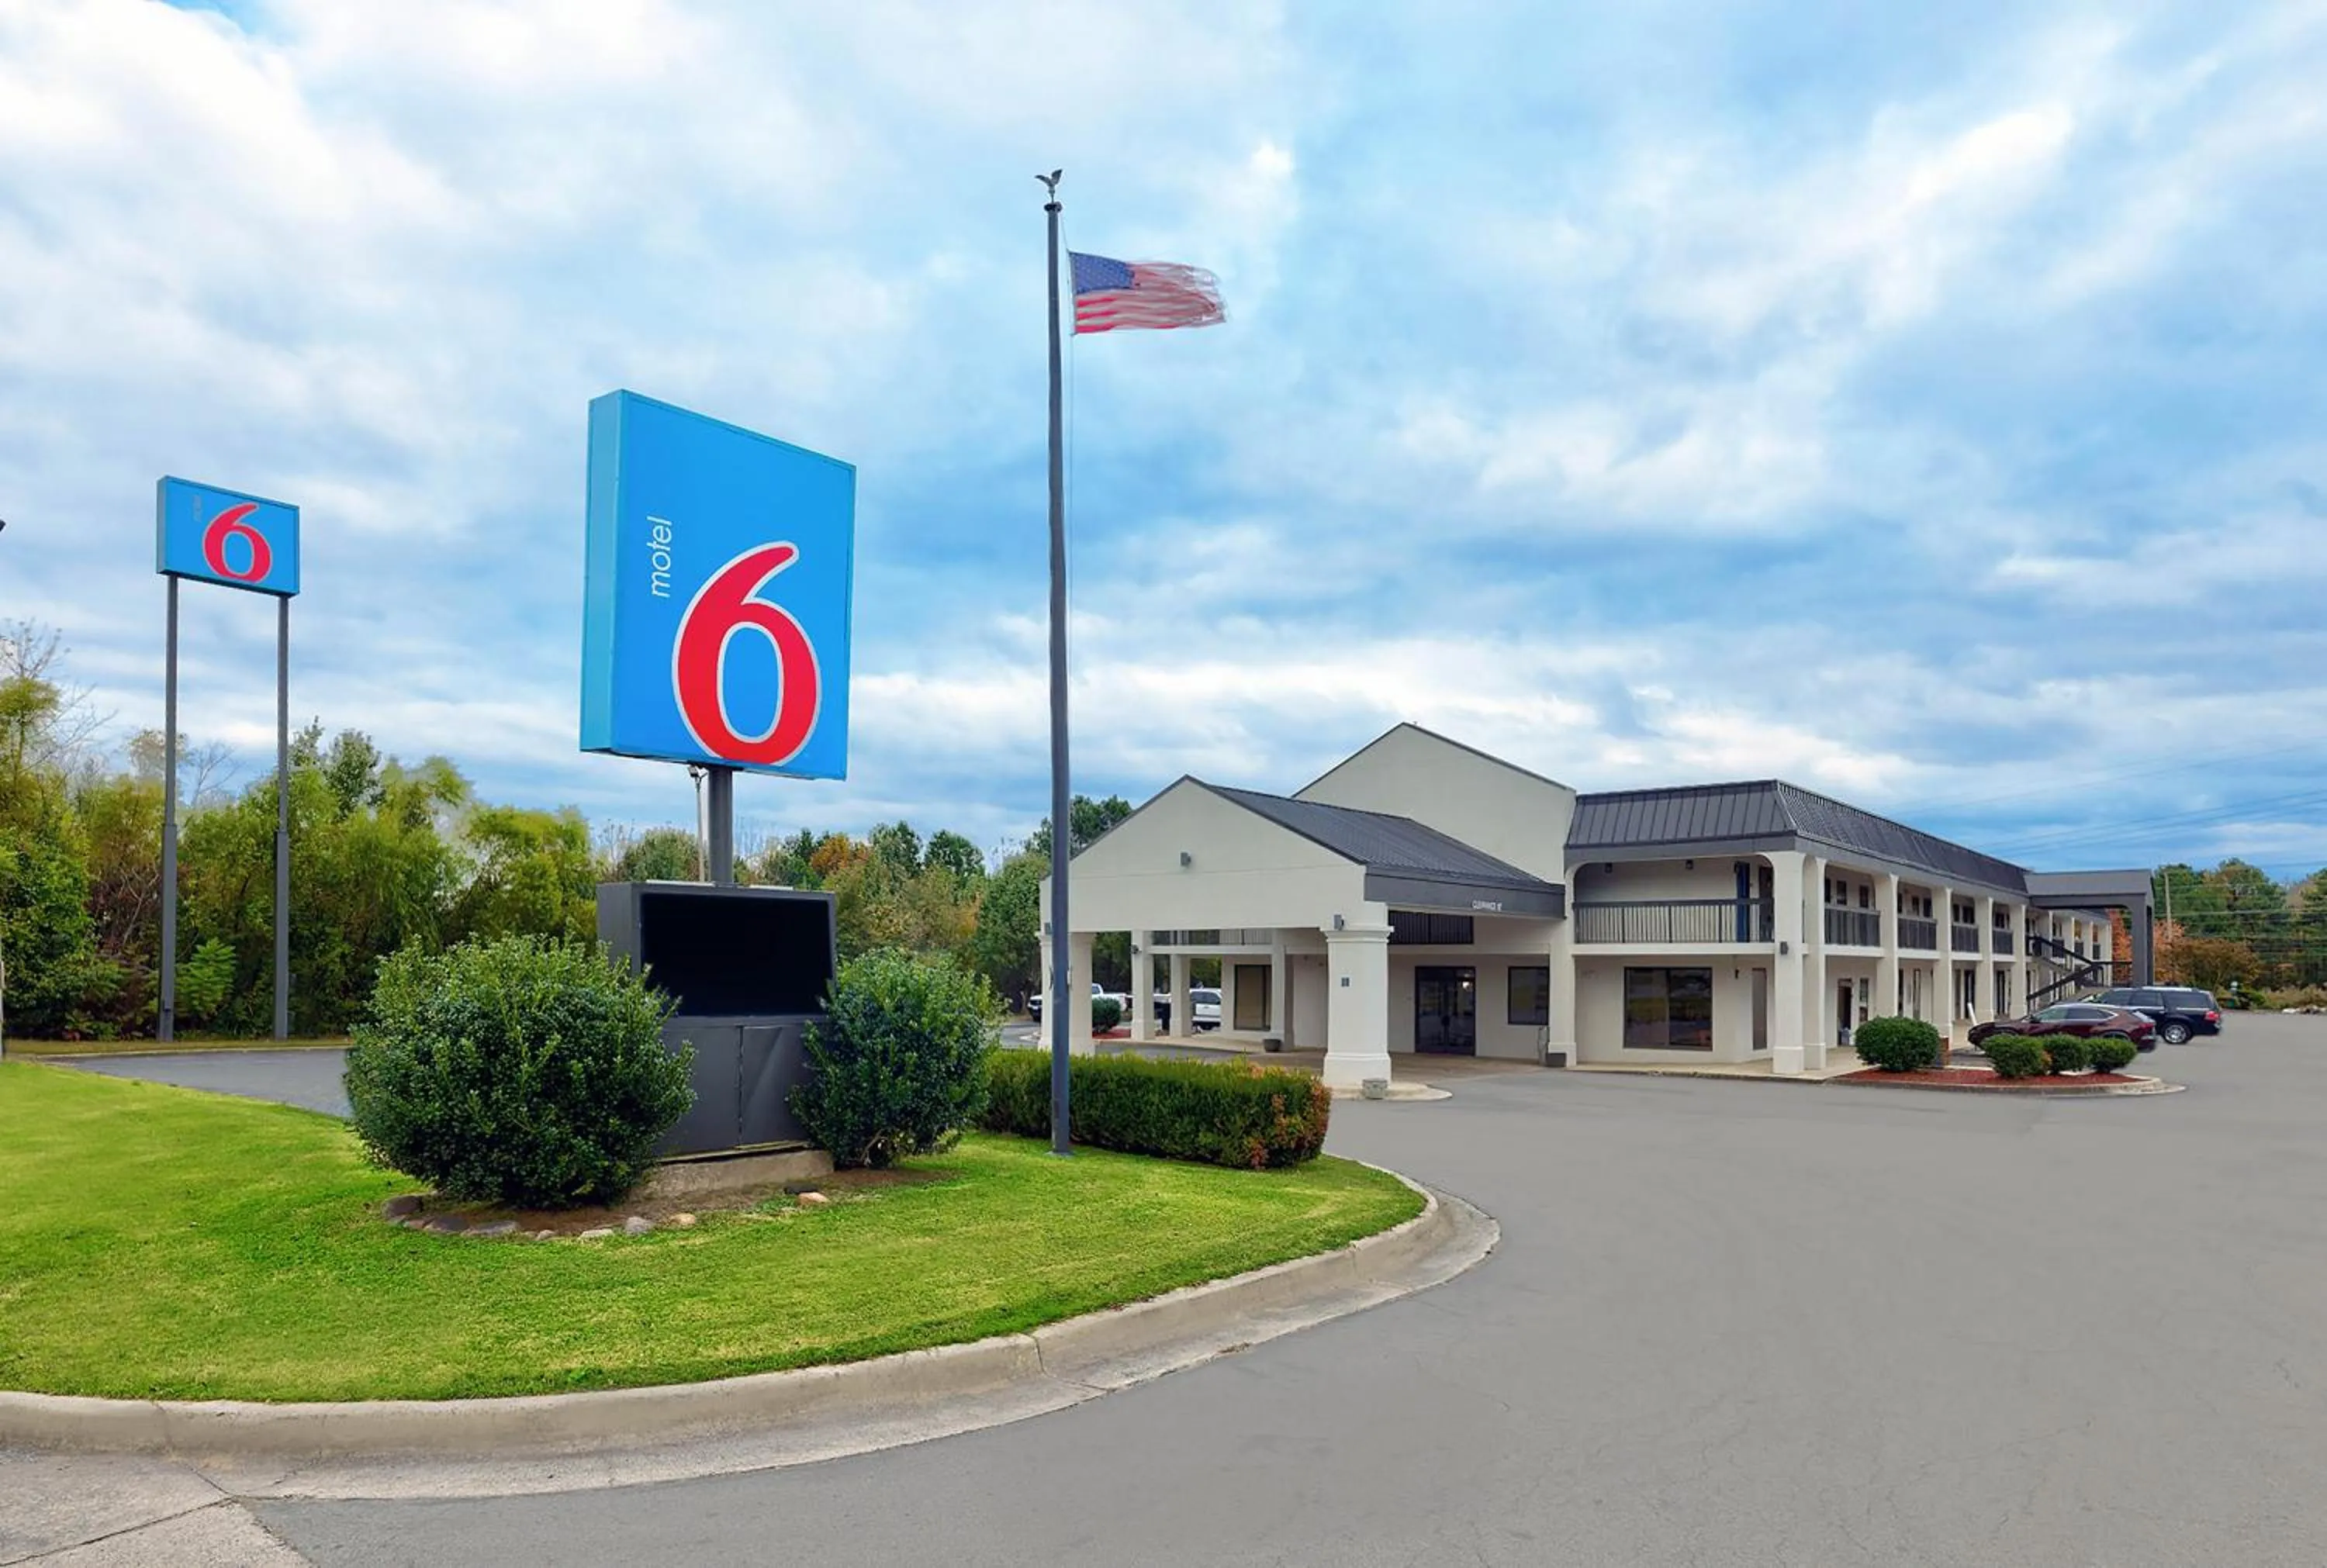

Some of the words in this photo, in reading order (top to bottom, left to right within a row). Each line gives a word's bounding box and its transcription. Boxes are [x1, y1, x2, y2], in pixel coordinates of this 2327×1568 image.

[202, 503, 273, 583] 6
[646, 516, 673, 598] motel
[672, 541, 821, 765] 6
